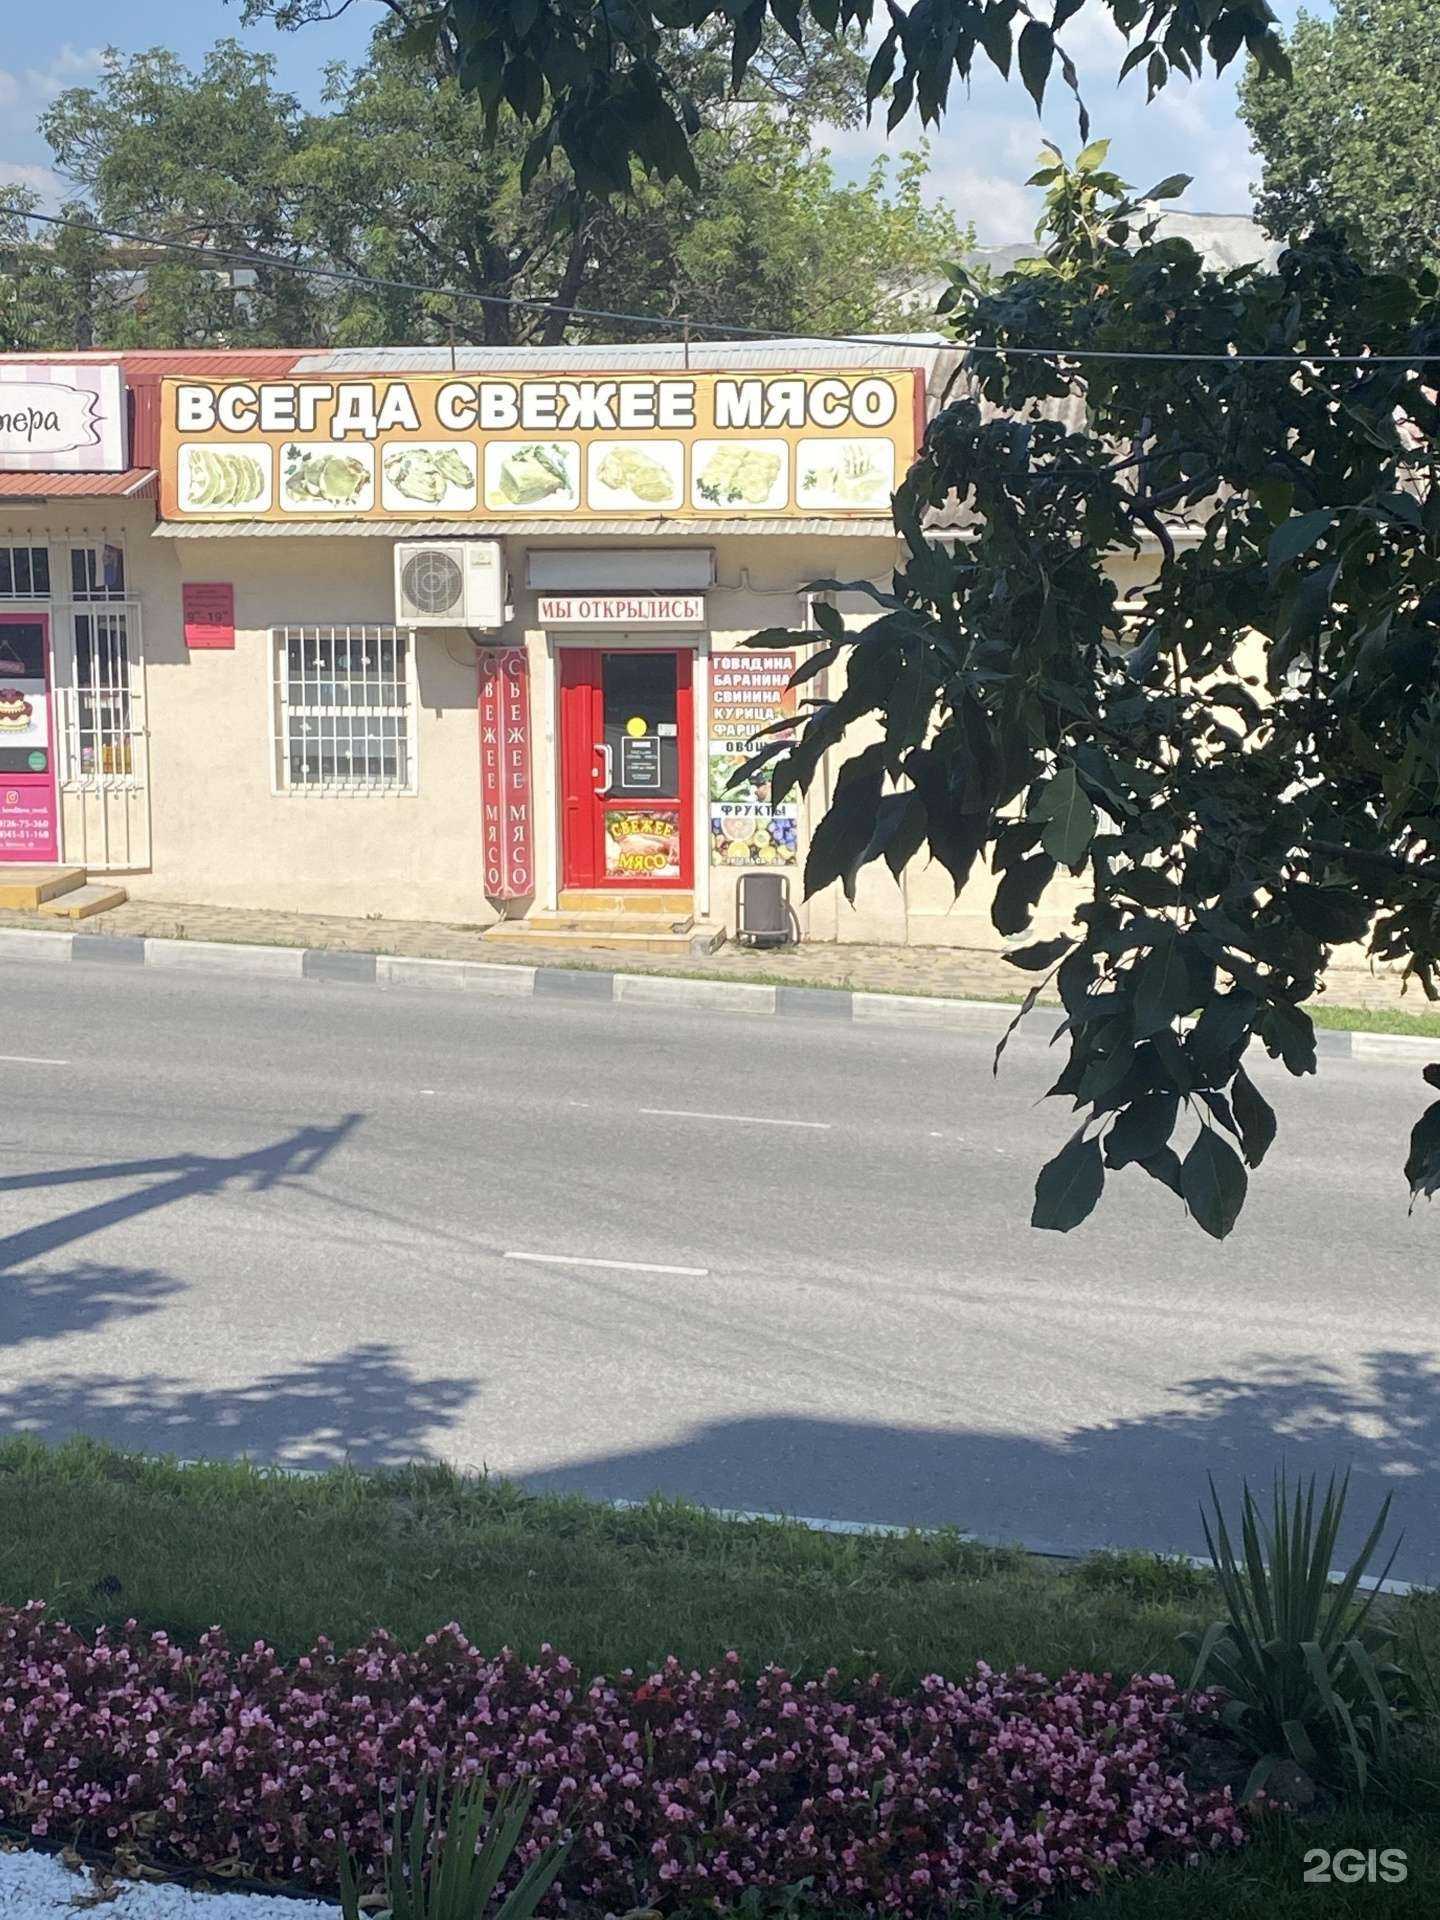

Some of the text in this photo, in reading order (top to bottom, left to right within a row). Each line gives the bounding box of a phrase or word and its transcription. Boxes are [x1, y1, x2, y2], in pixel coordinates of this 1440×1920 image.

[176, 377, 897, 439] ВСЕГДА СВЕЖЕЕ МЯСО
[579, 600, 699, 619] ОТКРЫЛИСЬ!
[713, 657, 793, 671] ГОВЯДИНА
[713, 674, 790, 686] БАРАНИНА
[713, 691, 781, 703] СВИНИНА
[713, 708, 775, 721] КУРИЦА
[483, 659, 499, 884] СВЕЖЕЕ МЯСО
[507, 659, 527, 884] СВЕЖЕЕ МЯСО
[721, 805, 786, 816] ФРУКТЫ
[611, 820, 673, 838] СВЕЖЕЕ
[619, 853, 667, 872] МЯСО
